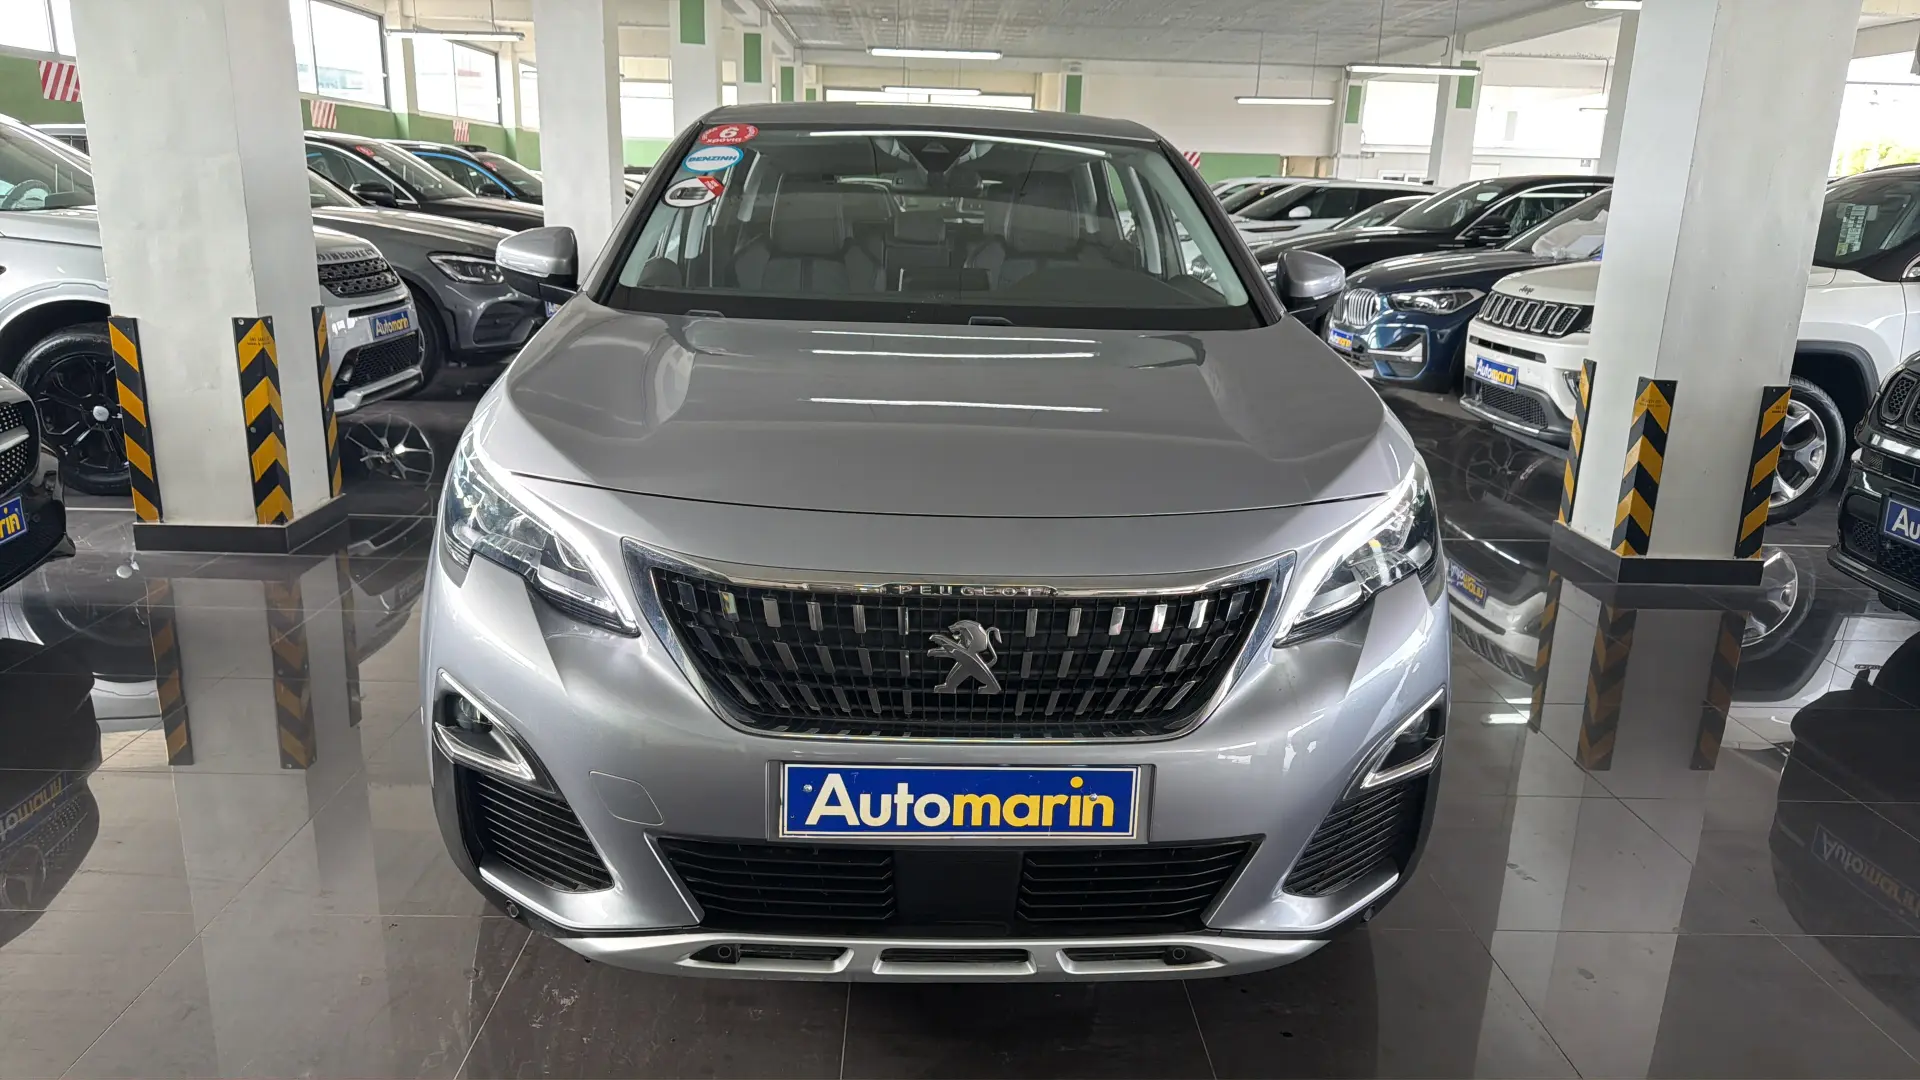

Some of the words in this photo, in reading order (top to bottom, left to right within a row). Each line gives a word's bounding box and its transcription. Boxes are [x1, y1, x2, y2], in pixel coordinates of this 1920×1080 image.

[719, 126, 739, 138] 6
[1476, 358, 1515, 386] Automarin
[898, 584, 1041, 597] PEUGEOT
[804, 773, 1115, 828] Automarin
